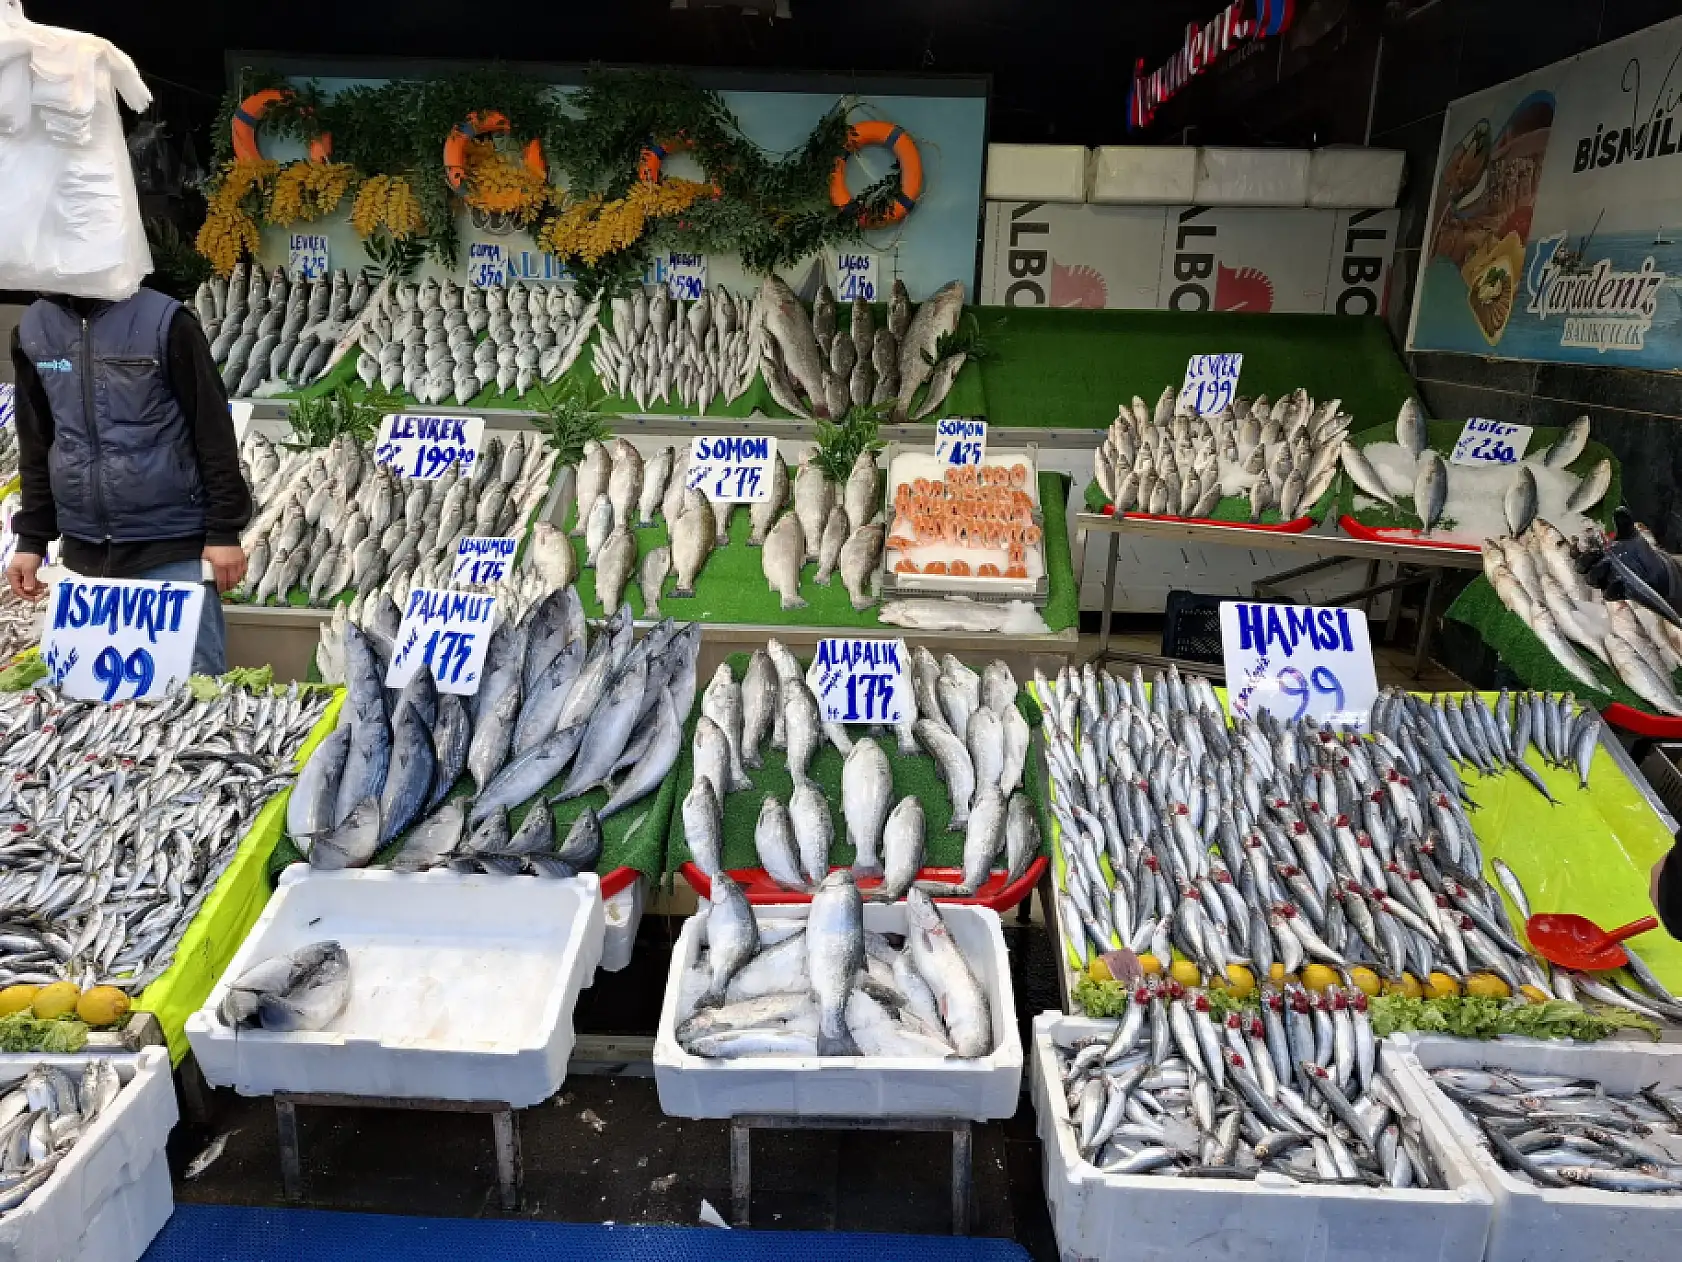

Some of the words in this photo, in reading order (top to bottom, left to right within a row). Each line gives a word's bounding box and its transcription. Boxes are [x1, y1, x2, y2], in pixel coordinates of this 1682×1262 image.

[1572, 108, 1682, 174] BİSMİL
[389, 415, 468, 445] LEVREK
[938, 420, 984, 440] SOMON
[696, 437, 768, 464] SOMON
[405, 589, 496, 626] PALAMUT
[91, 645, 156, 702] 99
[817, 639, 902, 676] ALABALIK
[1276, 665, 1346, 722] 99
